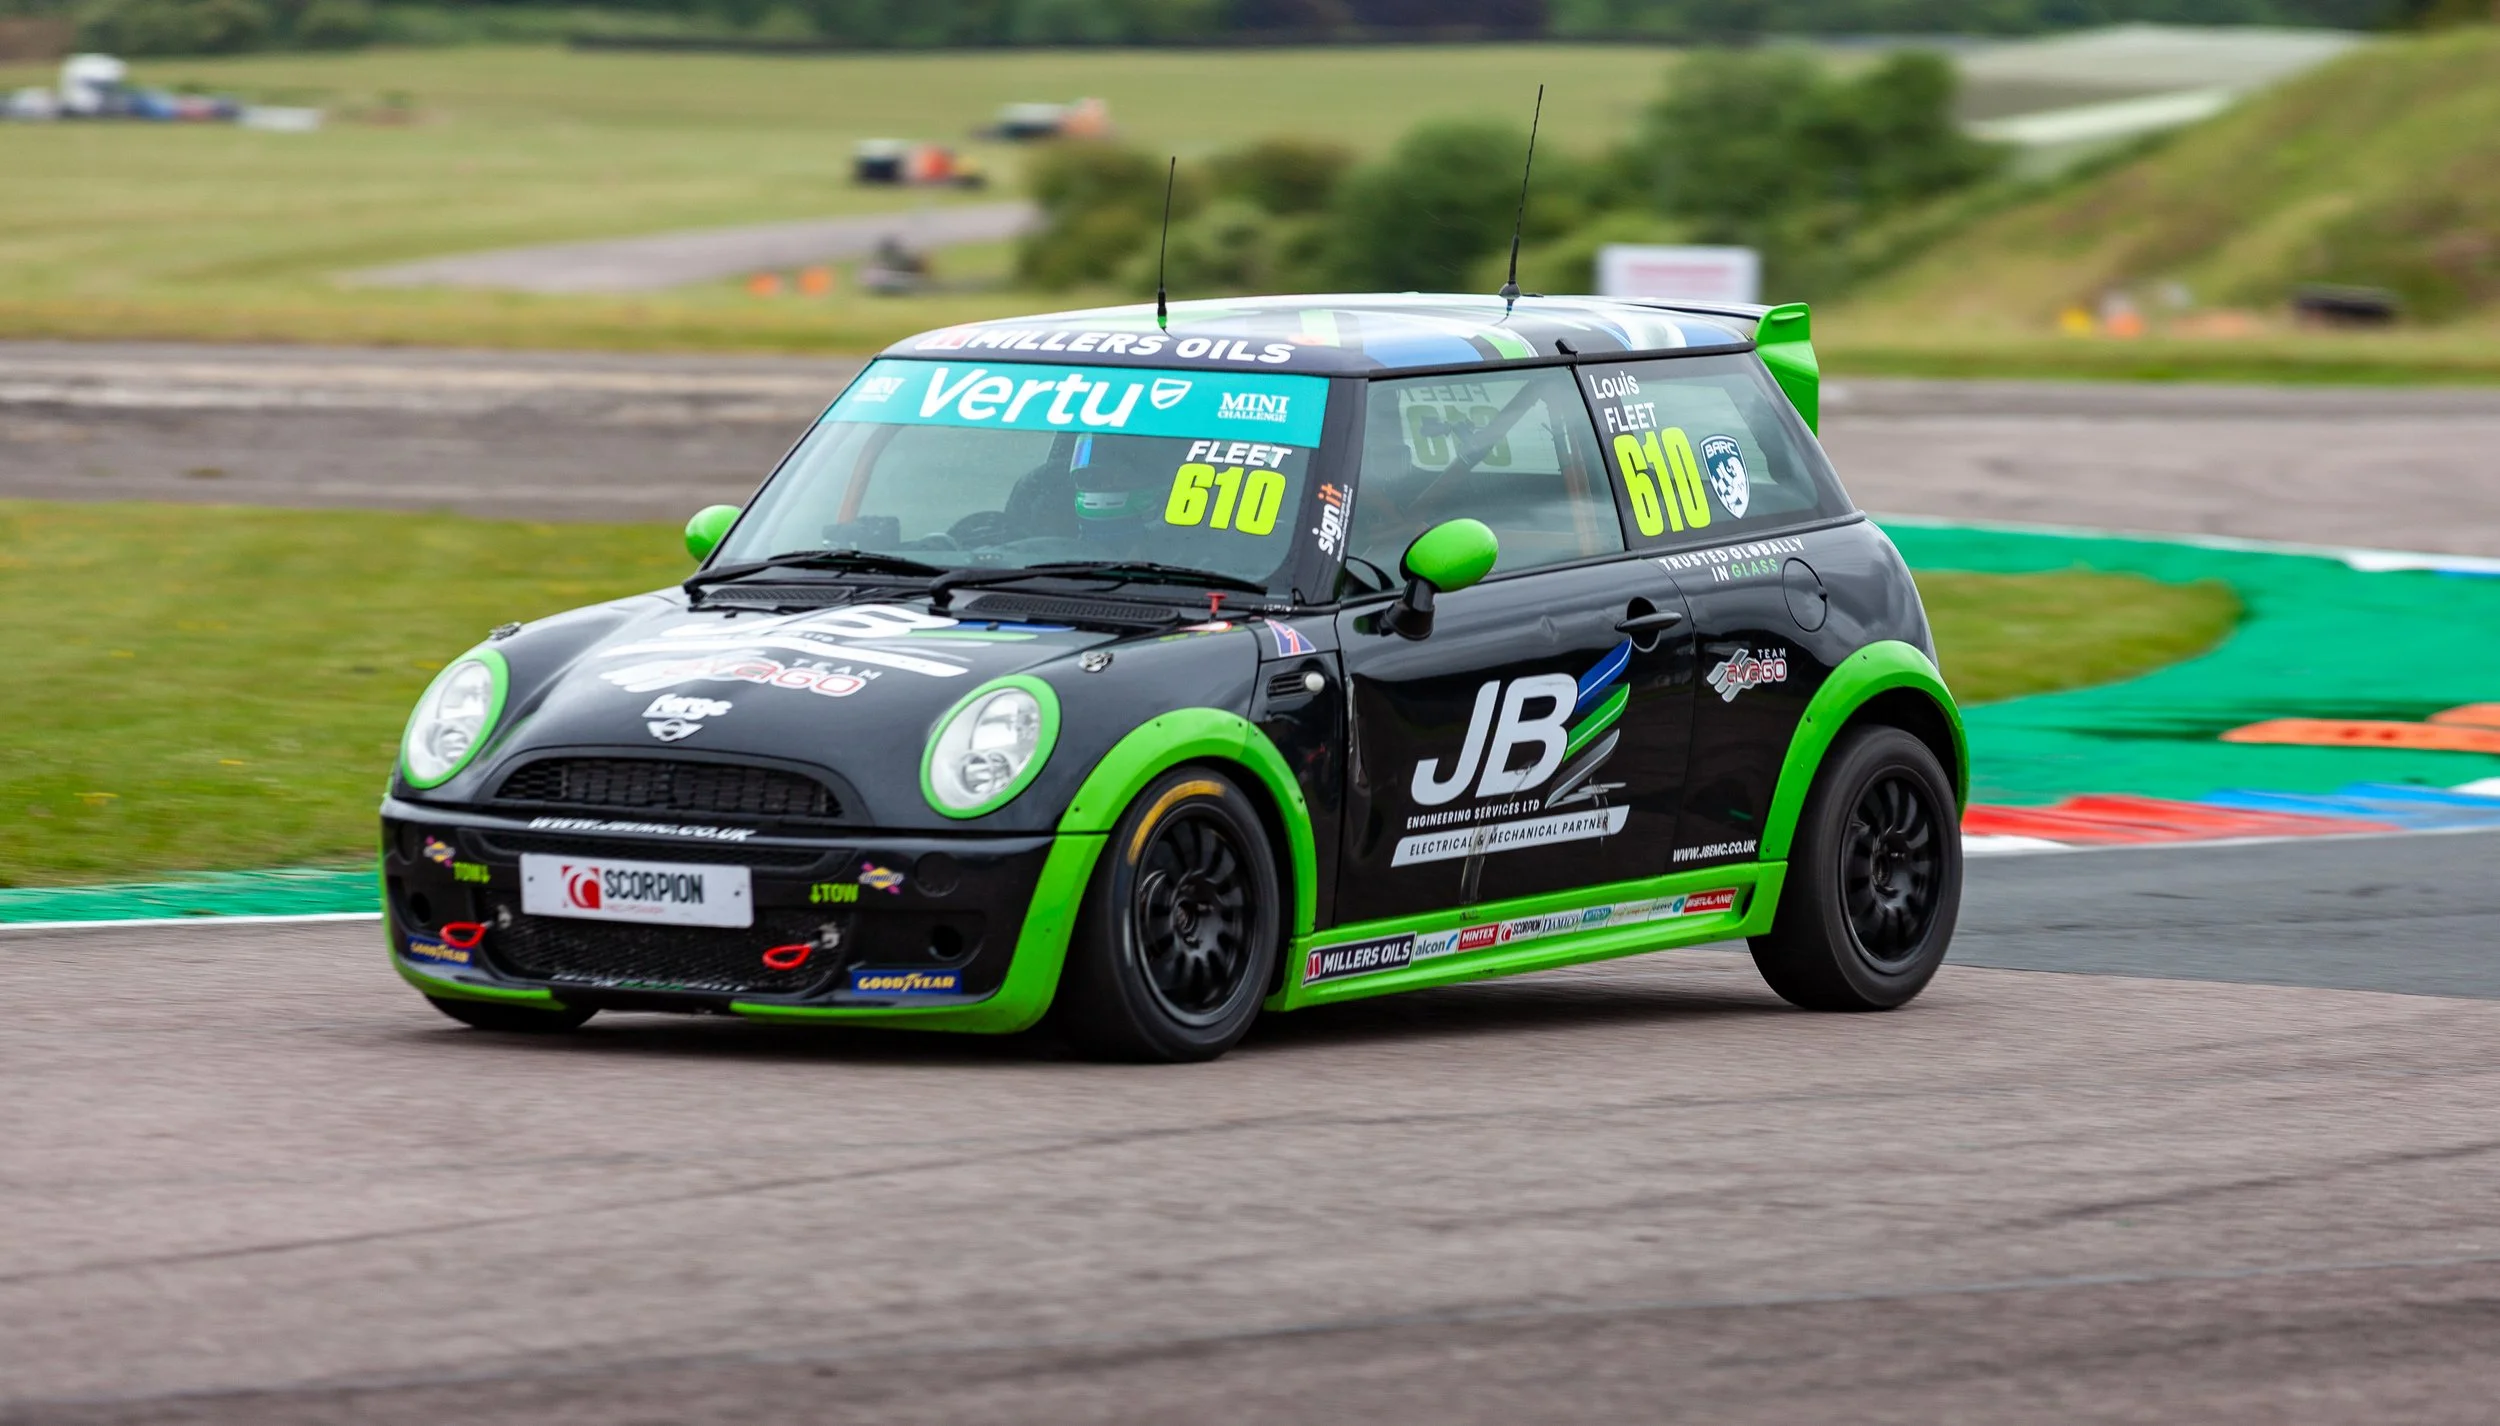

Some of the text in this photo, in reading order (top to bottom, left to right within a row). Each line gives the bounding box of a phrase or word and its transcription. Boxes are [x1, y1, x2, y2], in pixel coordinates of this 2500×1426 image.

[966, 330, 1296, 364] MILLERS OILS
[918, 367, 1144, 428] Vertu
[1589, 371, 1640, 399] Louis
[1217, 408, 1287, 423] CHALLENGE
[1220, 393, 1290, 414] MINI
[1604, 403, 1658, 433] FLEET
[1186, 440, 1292, 469] FLEET
[1705, 441, 1739, 459] BARC
[1613, 427, 1711, 537] 610
[1164, 463, 1287, 536] 610
[1659, 537, 1805, 571] TRUSTED GLOBALLY
[1711, 558, 1779, 582] IN GLASS
[1757, 648, 1787, 659] TEAM
[791, 657, 884, 681] TEAM
[1411, 673, 1578, 806] JB
[1406, 799, 1540, 829] ENGINEERING SERVICES LTD
[1409, 835, 1472, 857] ELECTRICAL
[1488, 824, 1558, 845] MECHANICAL
[1561, 816, 1609, 834] PARTNER
[1672, 840, 1757, 863] WWW.JBEMC.CO.UK
[604, 869, 704, 904] SCORPION
[820, 883, 860, 903] TOW
[1461, 927, 1495, 943] MINTEX
[1511, 920, 1542, 936] SCORPION
[1323, 940, 1411, 975] MILLERS OILS
[1415, 940, 1446, 957] alcon
[857, 972, 956, 992] GOODYEAR
